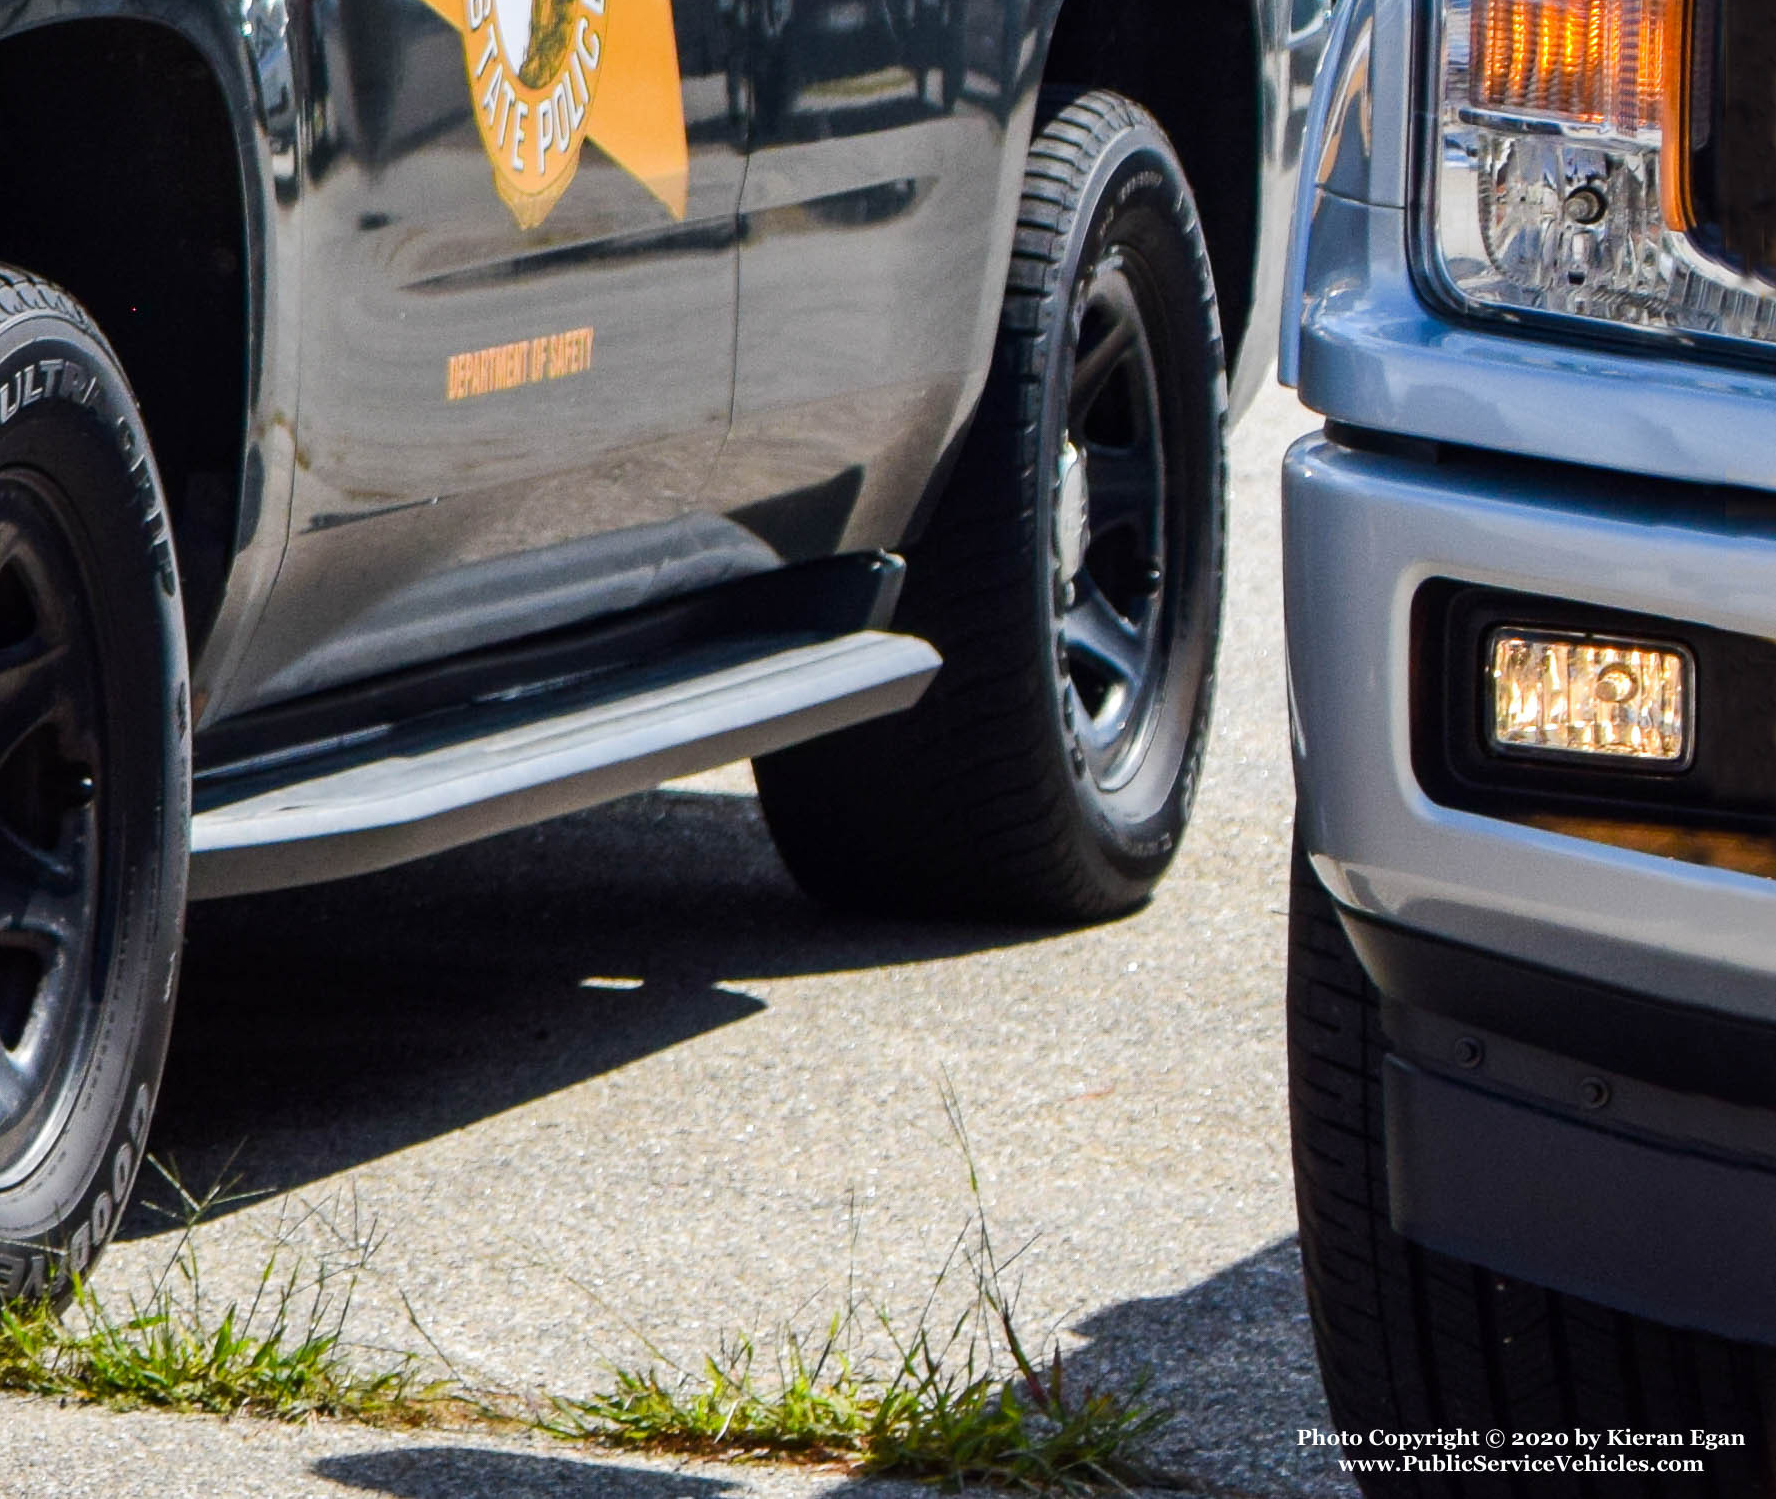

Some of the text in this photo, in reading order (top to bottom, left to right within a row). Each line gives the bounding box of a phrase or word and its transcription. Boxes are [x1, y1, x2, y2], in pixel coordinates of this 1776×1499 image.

[448, 325, 595, 402] DEPARTMENT OF SAFETY
